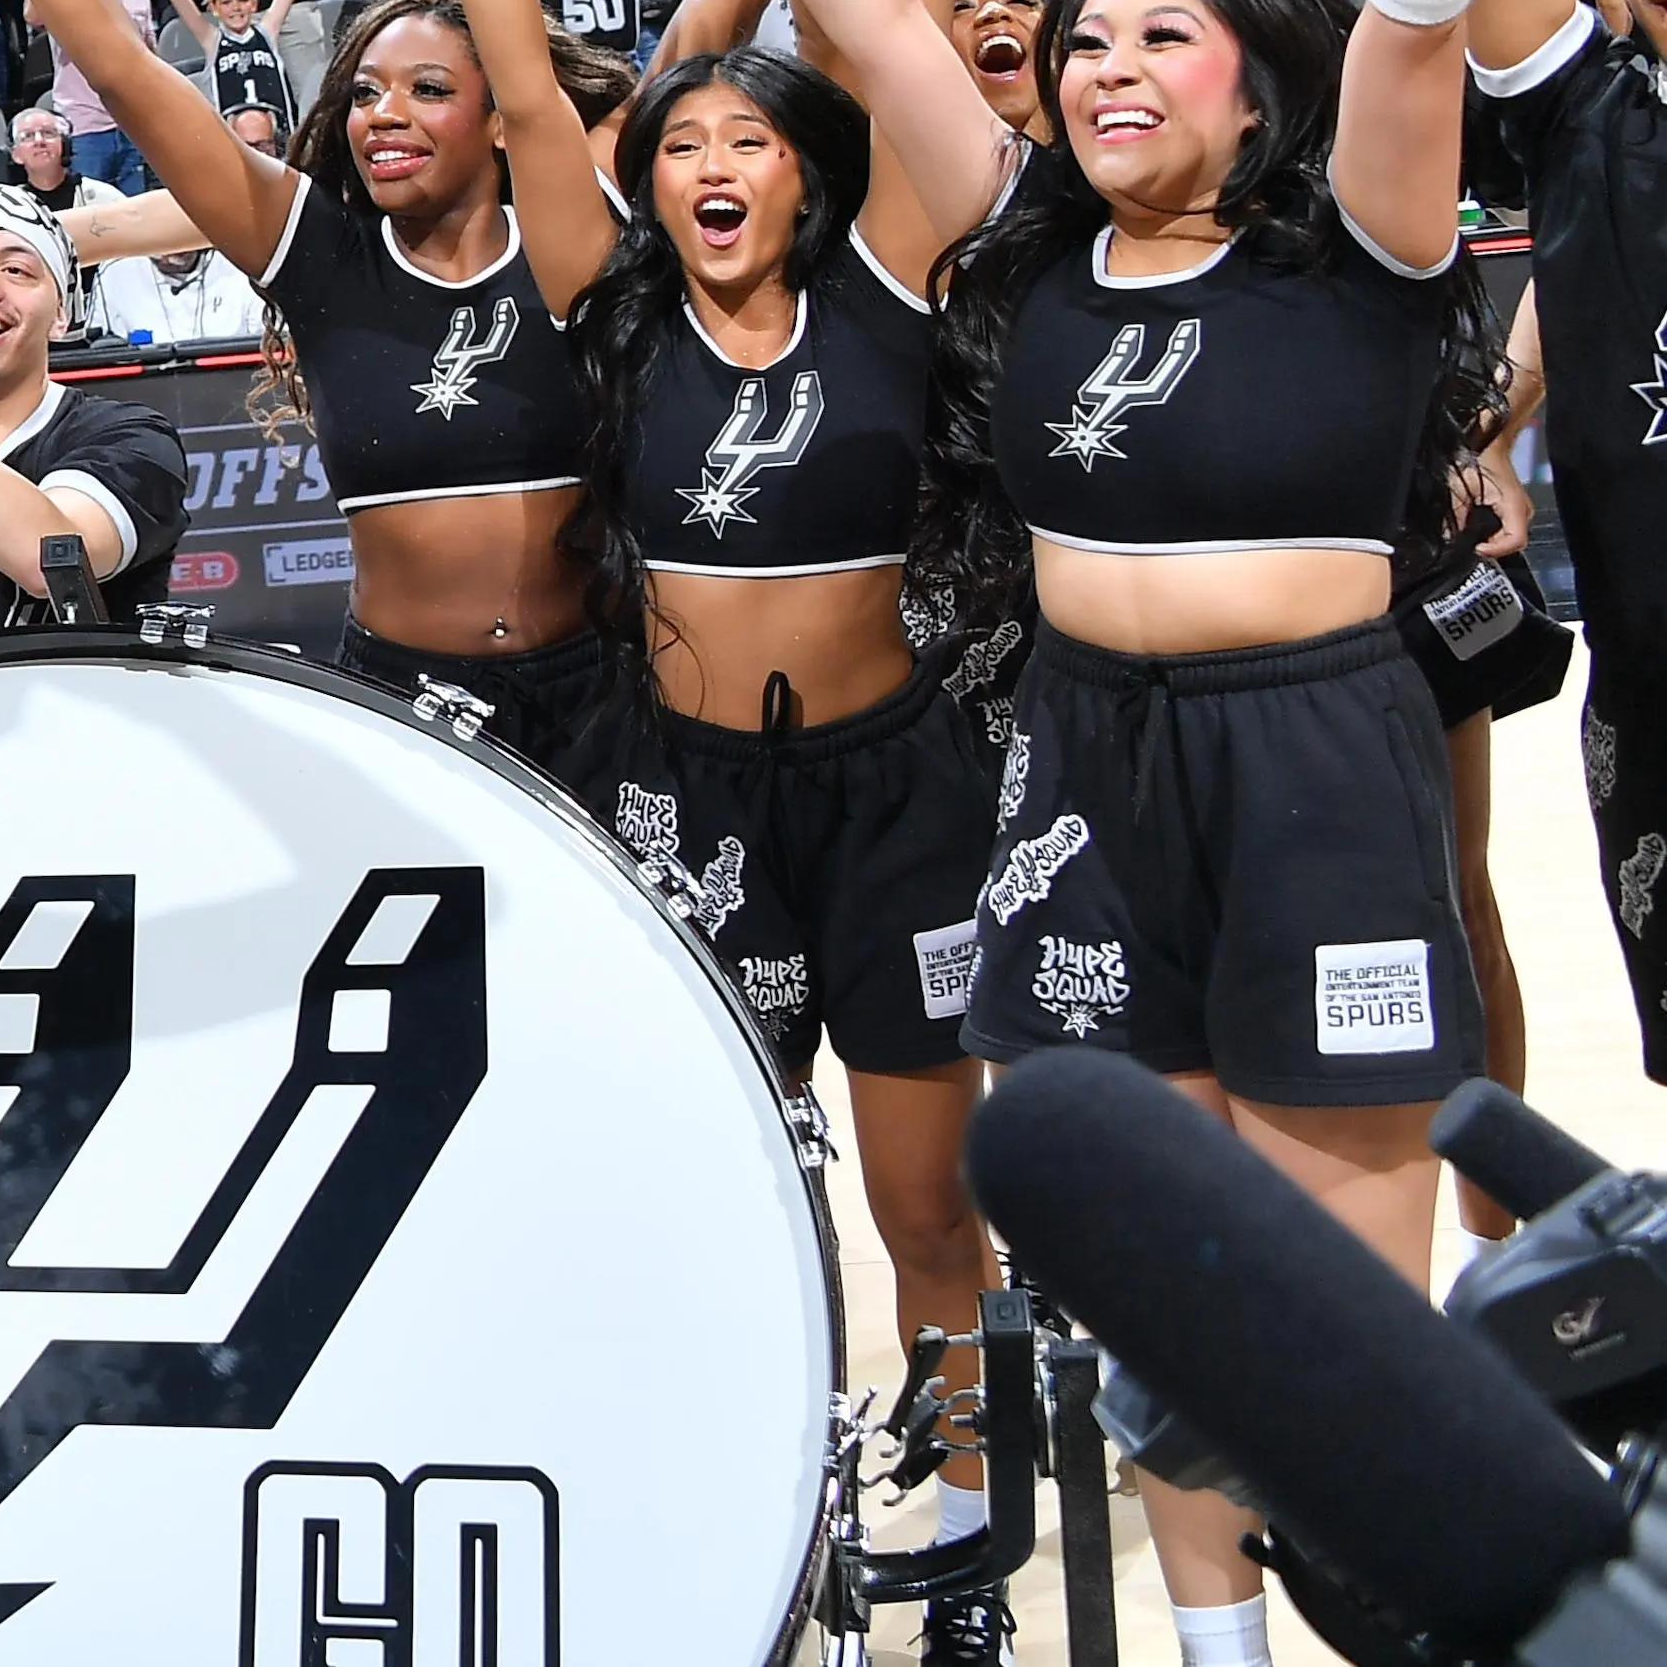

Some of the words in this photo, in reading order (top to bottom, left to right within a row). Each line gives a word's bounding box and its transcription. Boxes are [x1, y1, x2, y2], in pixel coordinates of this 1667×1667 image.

[218, 50, 275, 75] SPURS
[244, 79, 258, 103] 1
[186, 444, 331, 512] OFFS
[1445, 587, 1515, 643] SPURS
[618, 781, 677, 832] HYPE
[1037, 819, 1085, 871] SQUAD
[739, 953, 808, 987] HYPE
[922, 949, 948, 962] THE
[1037, 935, 1126, 977] HYPE
[1032, 970, 1130, 1004] SQUAD
[1326, 969, 1352, 983] THE
[1356, 964, 1419, 980] OFFICIAL
[746, 984, 809, 1012] SQUAD
[1327, 1001, 1425, 1028] SPURS
[243, 1460, 562, 1667] GO
